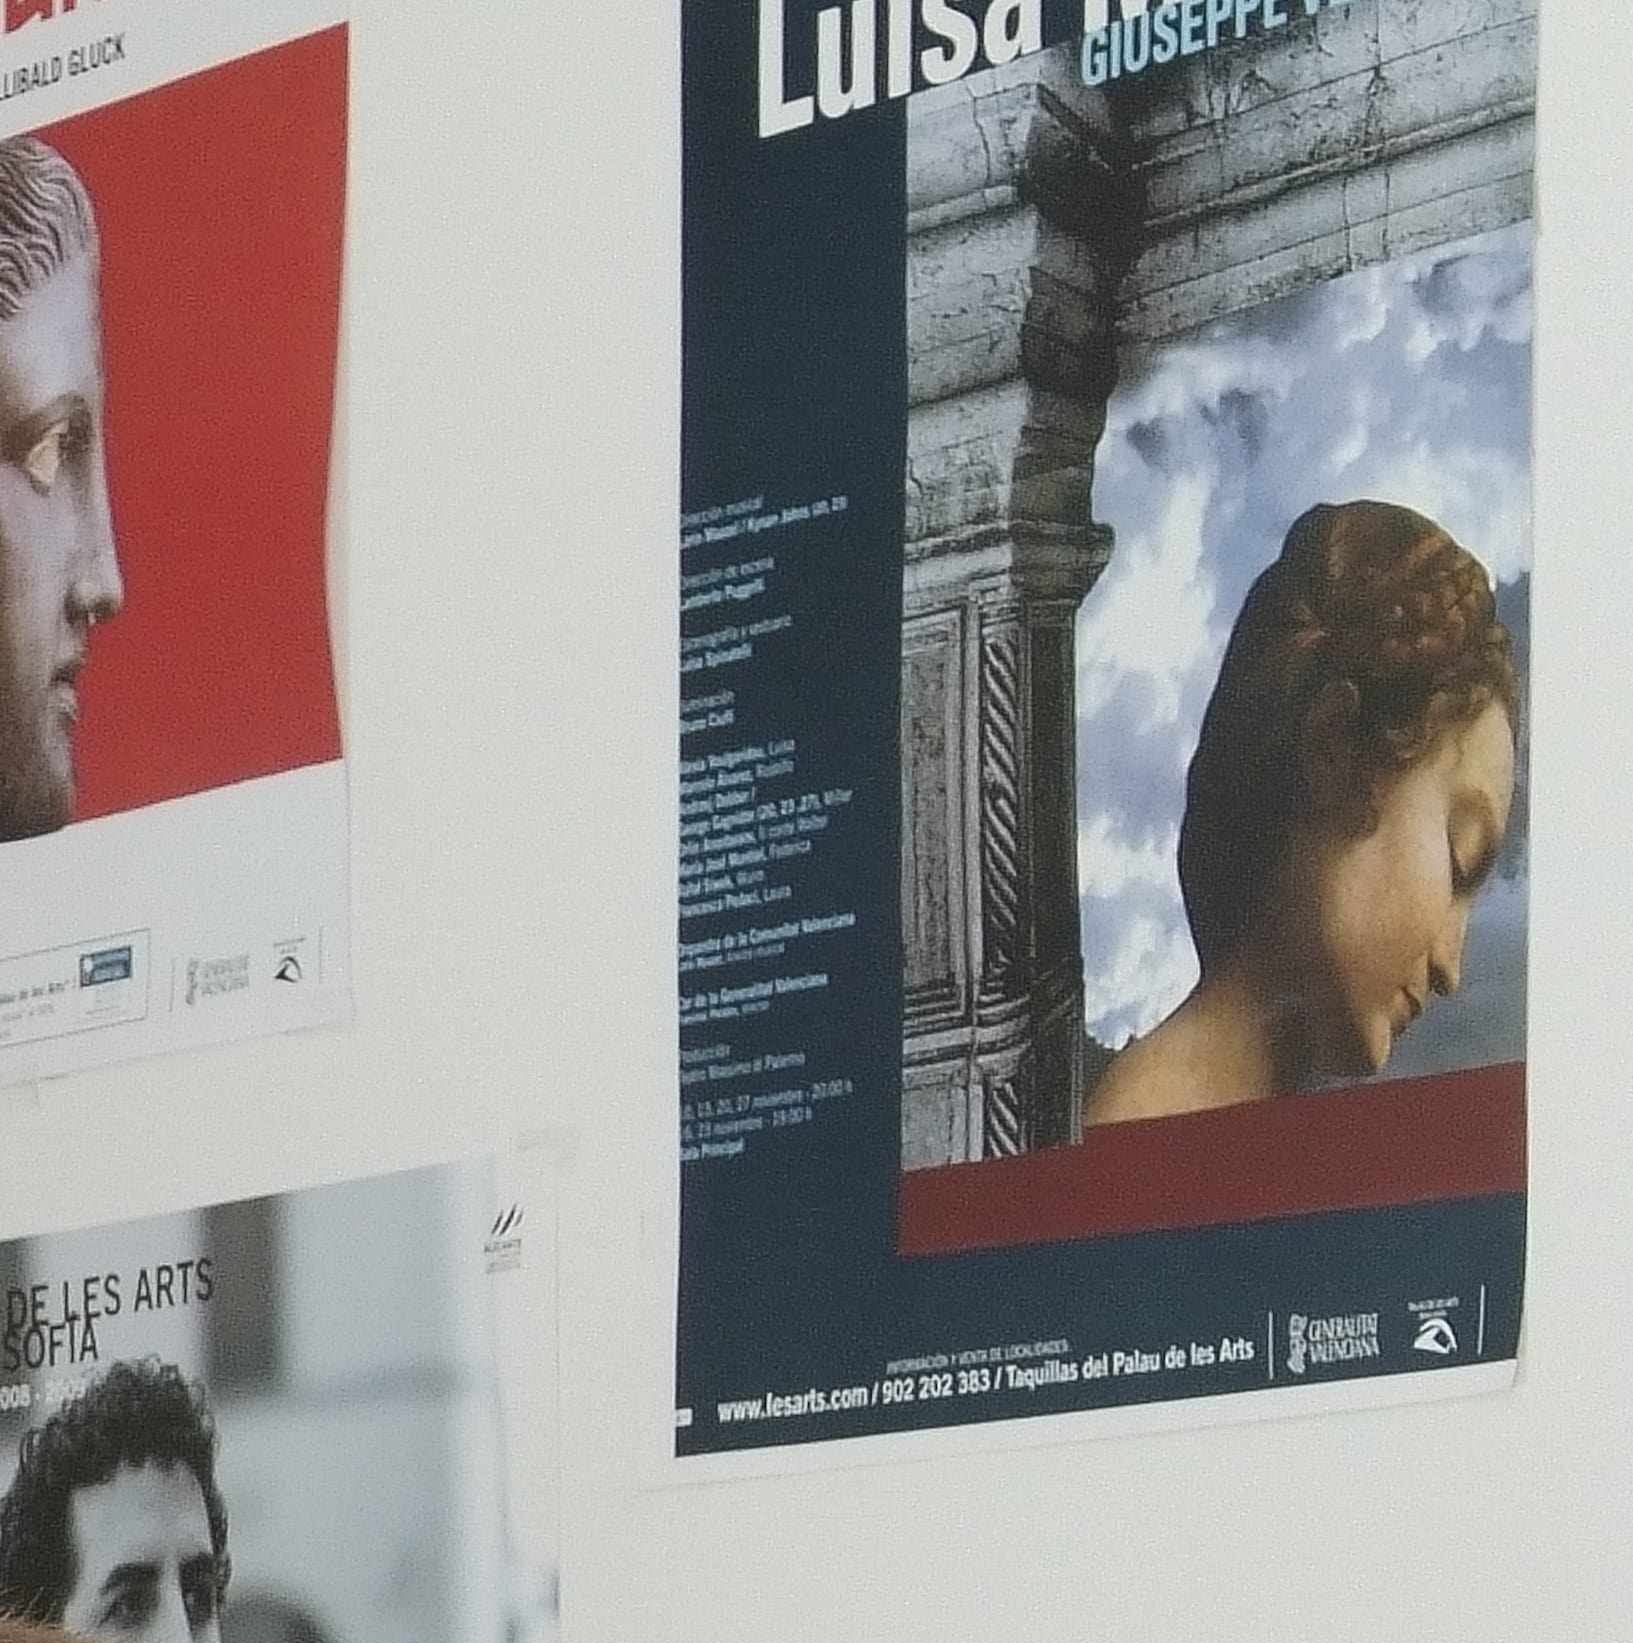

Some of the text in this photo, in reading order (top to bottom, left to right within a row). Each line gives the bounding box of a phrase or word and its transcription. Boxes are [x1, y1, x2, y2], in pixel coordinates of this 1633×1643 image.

[69, 32, 127, 77] GLUCK
[6, 1285, 50, 1330] DE
[64, 1275, 121, 1325] LES
[134, 1257, 215, 1313] ARTS
[718, 1386, 868, 1425] www.lesarts.com
[883, 1377, 914, 1404] 902
[919, 1372, 953, 1400] 202
[958, 1368, 990, 1394] 383
[1006, 1359, 1079, 1391] Taquillas
[1082, 1352, 1109, 1380] del
[1112, 1347, 1160, 1375] Palau
[1164, 1345, 1186, 1369] de
[1190, 1341, 1216, 1365] les
[1219, 1337, 1255, 1363] Arts
